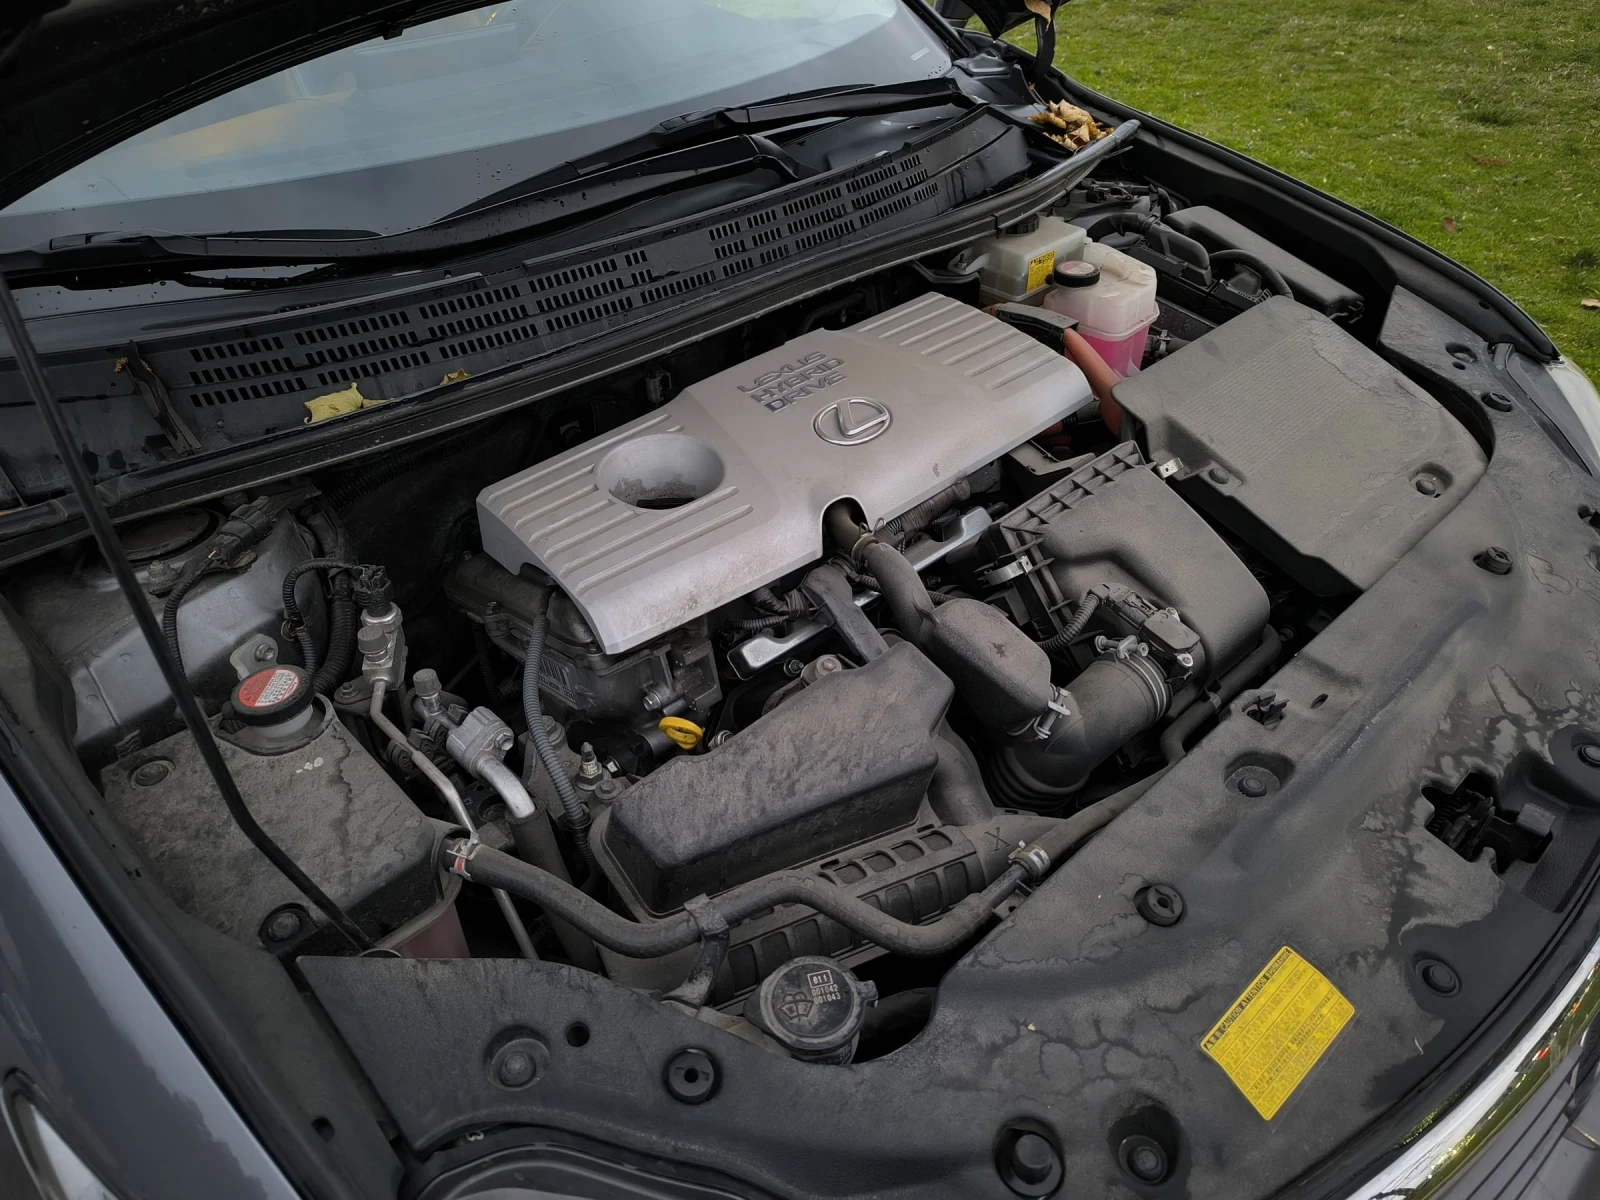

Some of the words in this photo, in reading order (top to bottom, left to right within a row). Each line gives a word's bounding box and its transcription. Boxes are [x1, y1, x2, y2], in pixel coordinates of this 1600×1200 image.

[737, 352, 827, 393] LEXUS
[750, 358, 845, 404] HYBRID
[764, 371, 847, 413] DRIVE
[811, 984, 839, 996] 001042
[812, 974, 828, 984] e11
[813, 992, 841, 1004] 001043
[1219, 1005, 1243, 1031] CAUTION
[1239, 975, 1268, 1007] ATTENTION
